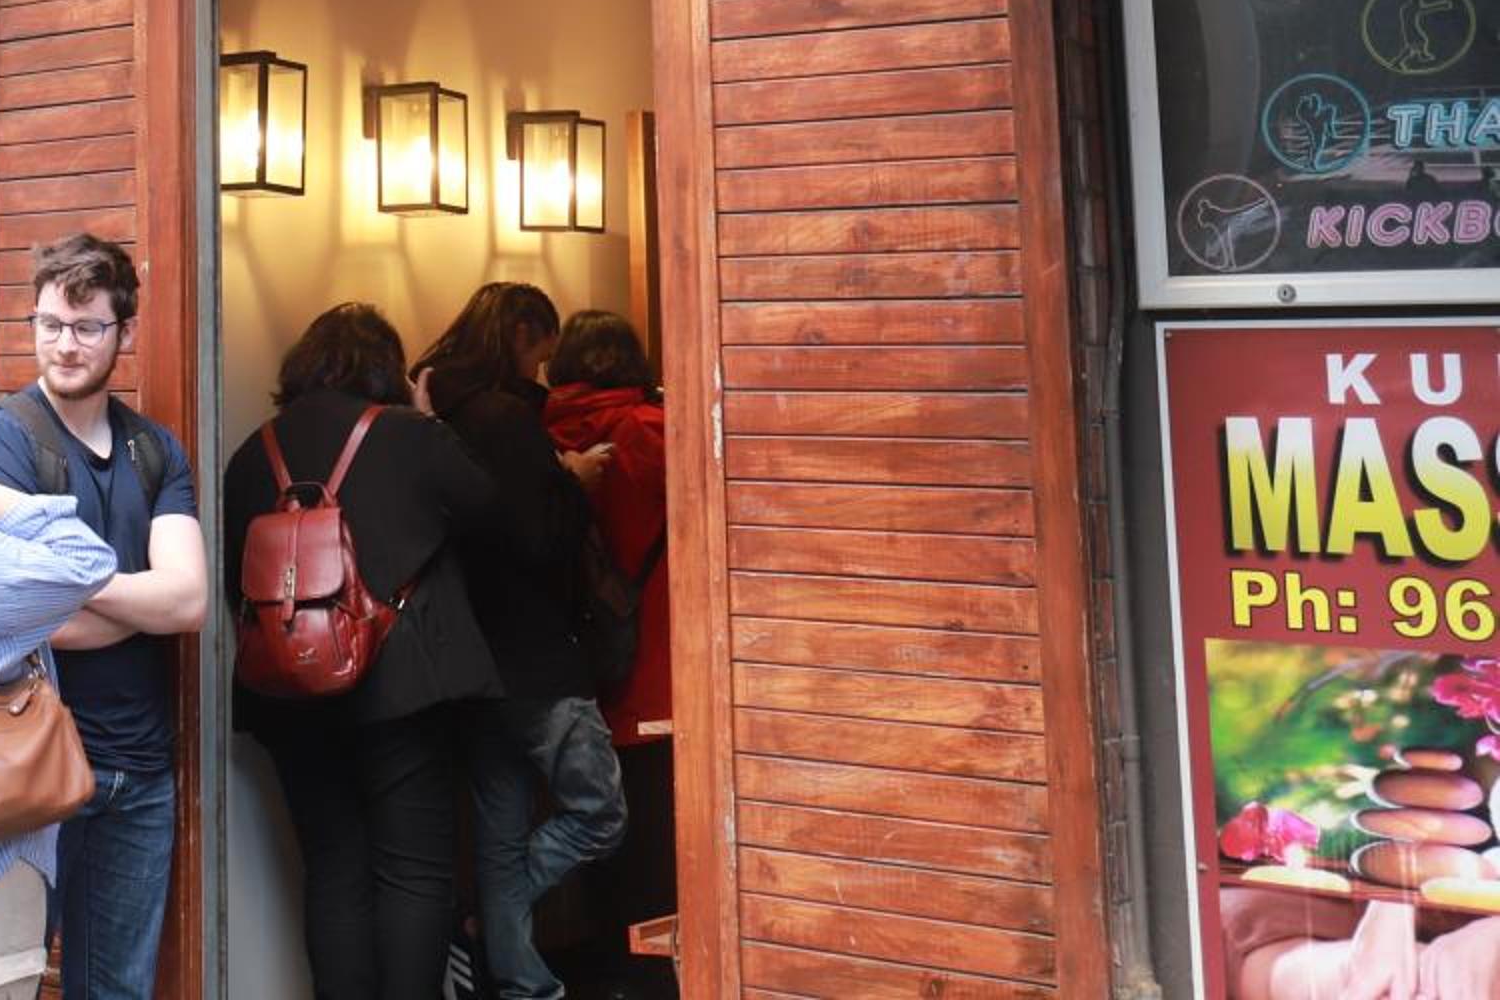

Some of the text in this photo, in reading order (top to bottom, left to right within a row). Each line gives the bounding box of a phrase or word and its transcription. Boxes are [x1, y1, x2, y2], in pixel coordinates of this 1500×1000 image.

[1307, 200, 1500, 250] KICKB
[1225, 416, 1500, 562] MAS
[1230, 569, 1496, 641] Ph: 96
